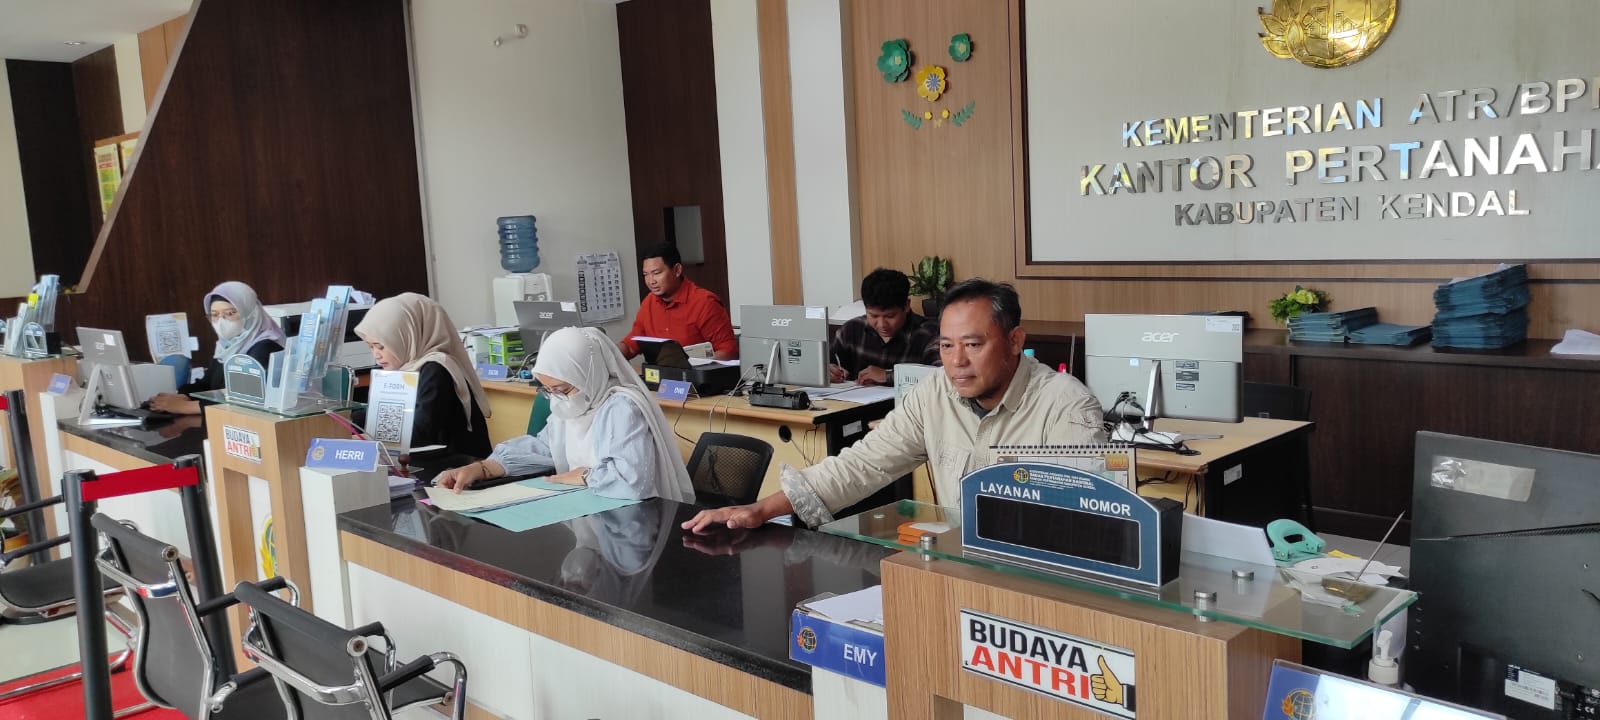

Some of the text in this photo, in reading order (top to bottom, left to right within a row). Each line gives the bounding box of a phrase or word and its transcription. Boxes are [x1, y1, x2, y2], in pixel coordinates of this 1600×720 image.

[1122, 98, 1384, 148] KEMENTERIAN
[1080, 128, 1600, 196] KANTOR PERTANAH
[1174, 188, 1531, 226] KABUPATEN KENDAL
[771, 318, 793, 327] acer
[1141, 331, 1180, 343] acer
[225, 428, 250, 444] BUDAYA
[227, 440, 252, 457] ANTRI
[335, 449, 365, 461] HERRI
[980, 482, 1041, 501] LAYANAN
[1079, 496, 1131, 517] NOMOR
[843, 643, 877, 667] EMY
[969, 618, 1089, 673] BUDAYA
[970, 644, 1090, 700] ANTRI
